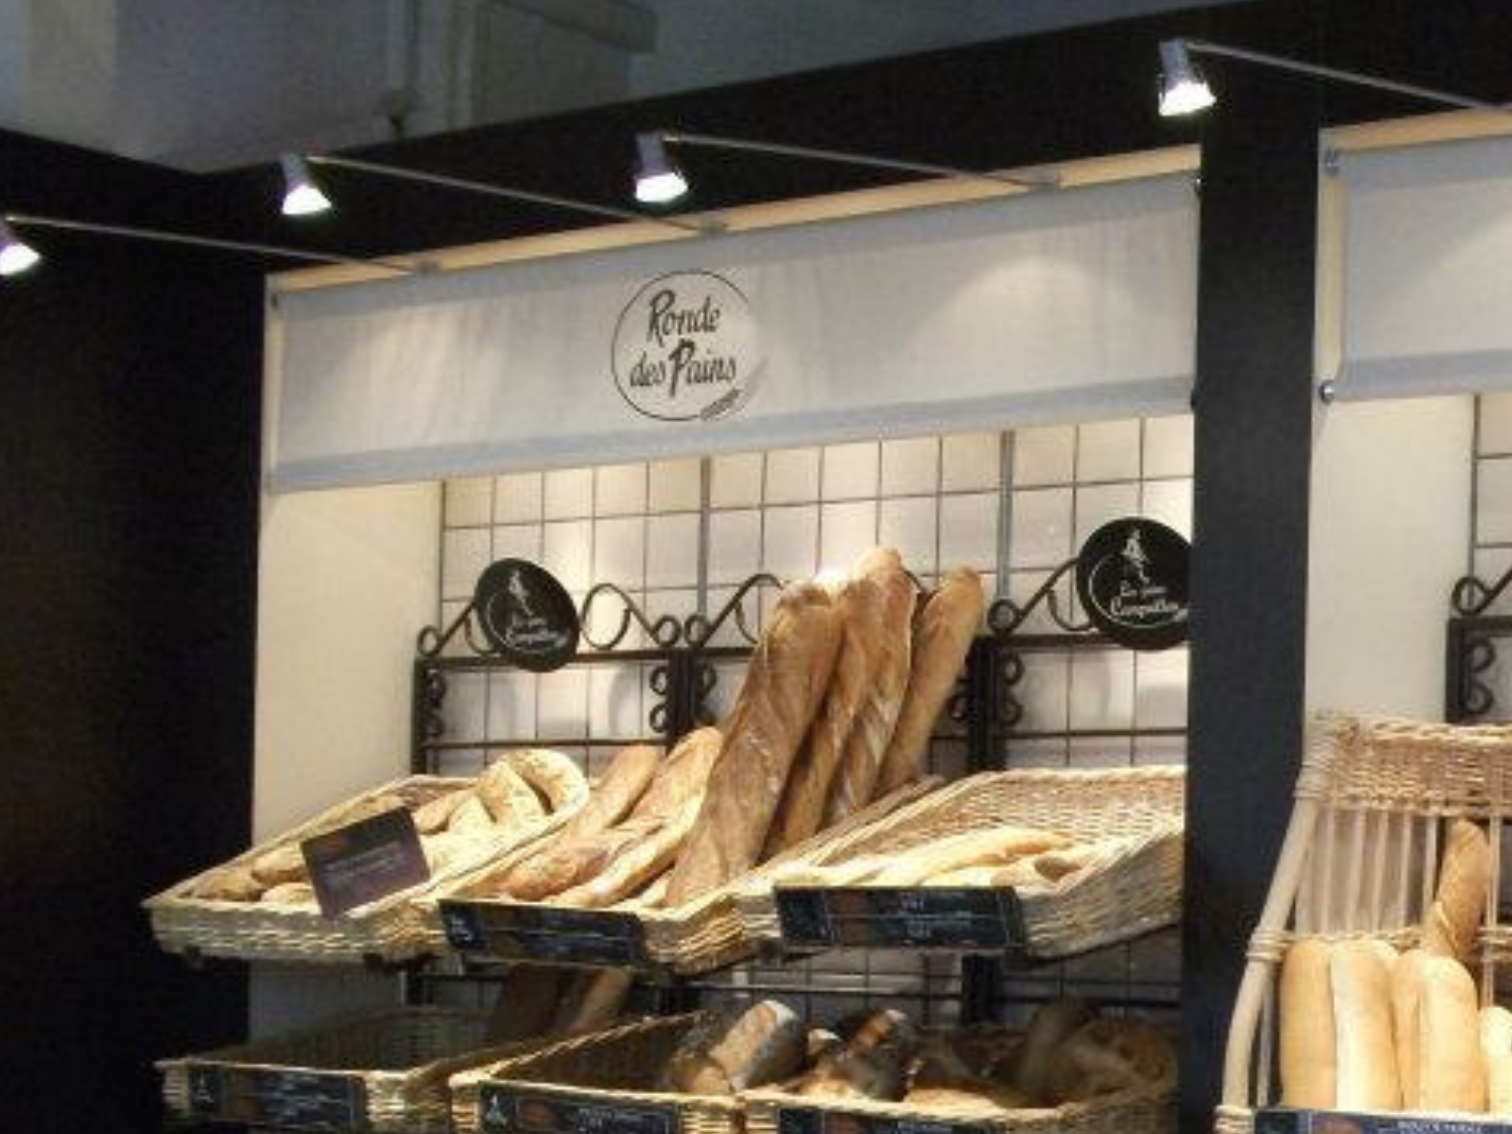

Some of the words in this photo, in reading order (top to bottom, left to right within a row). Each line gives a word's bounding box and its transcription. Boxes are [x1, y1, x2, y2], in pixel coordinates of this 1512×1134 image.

[647, 289, 721, 347] Ronde
[630, 351, 667, 388] des
[668, 338, 737, 397] Pains
